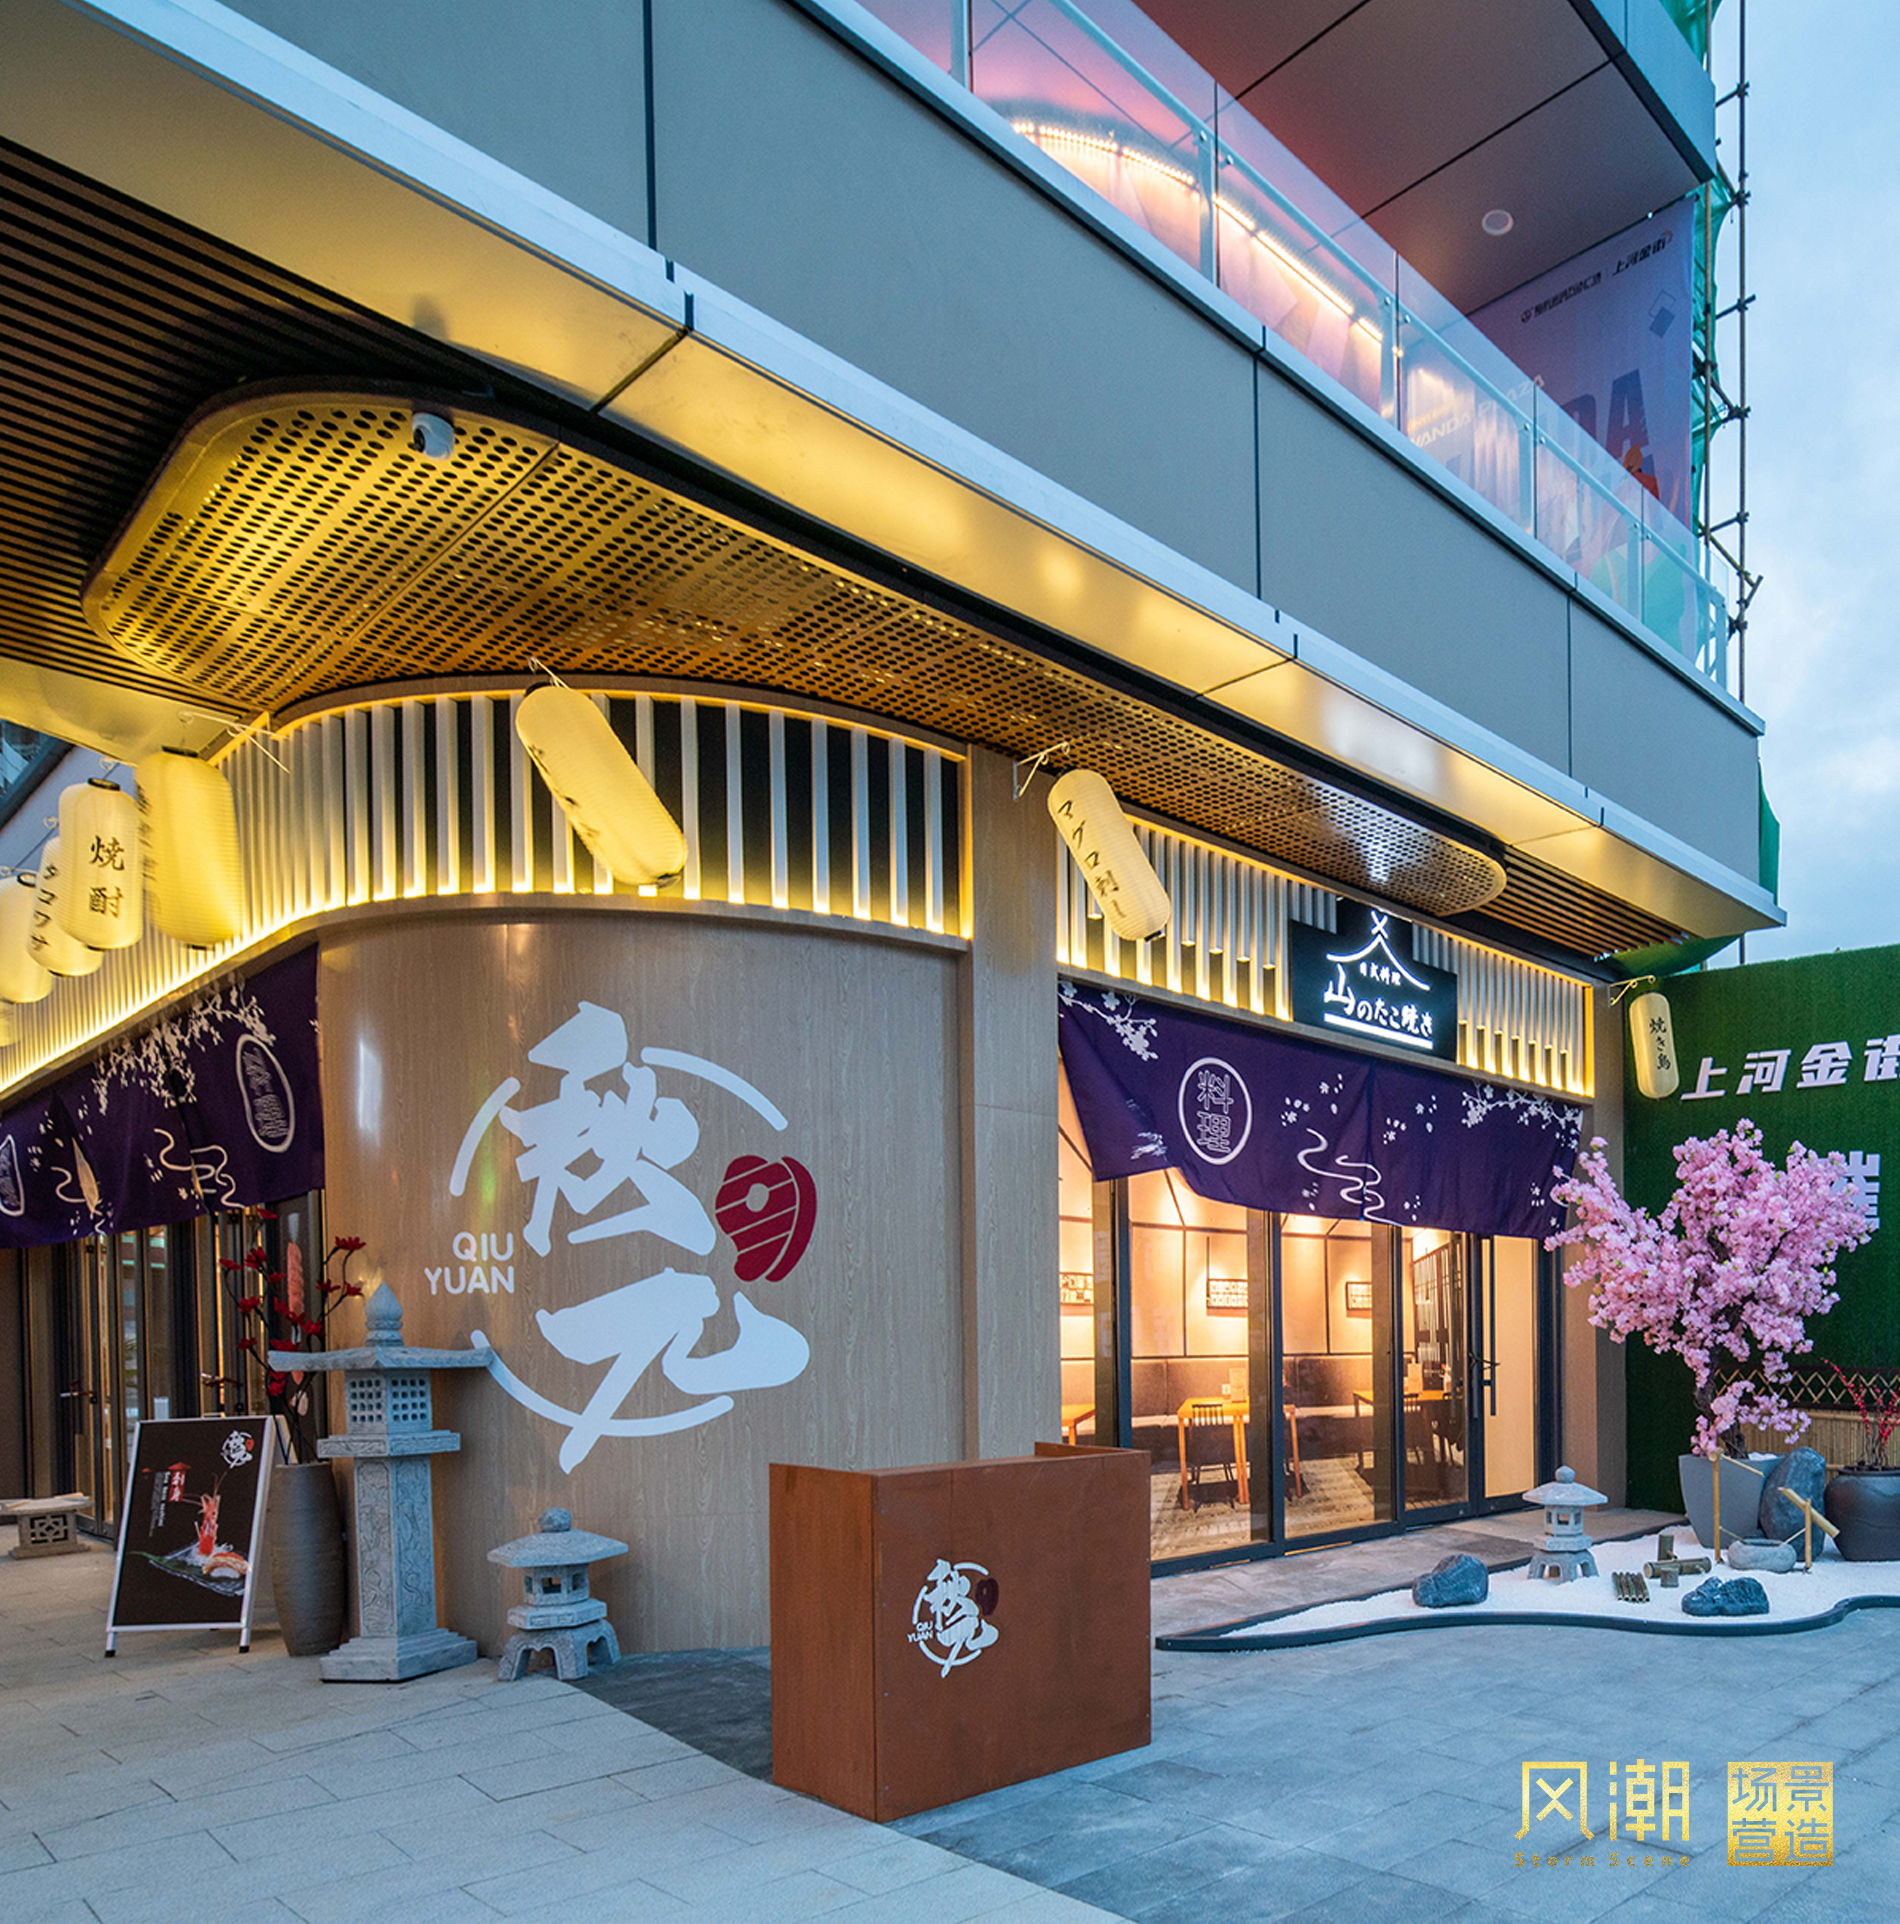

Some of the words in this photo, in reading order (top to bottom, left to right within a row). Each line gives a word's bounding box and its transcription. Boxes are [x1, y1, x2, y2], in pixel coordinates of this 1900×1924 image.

[1197, 1069, 1235, 1154] 料理
[452, 1231, 514, 1262] QIU
[423, 1265, 515, 1296] YUAN
[907, 1630, 934, 1643] YUAN
